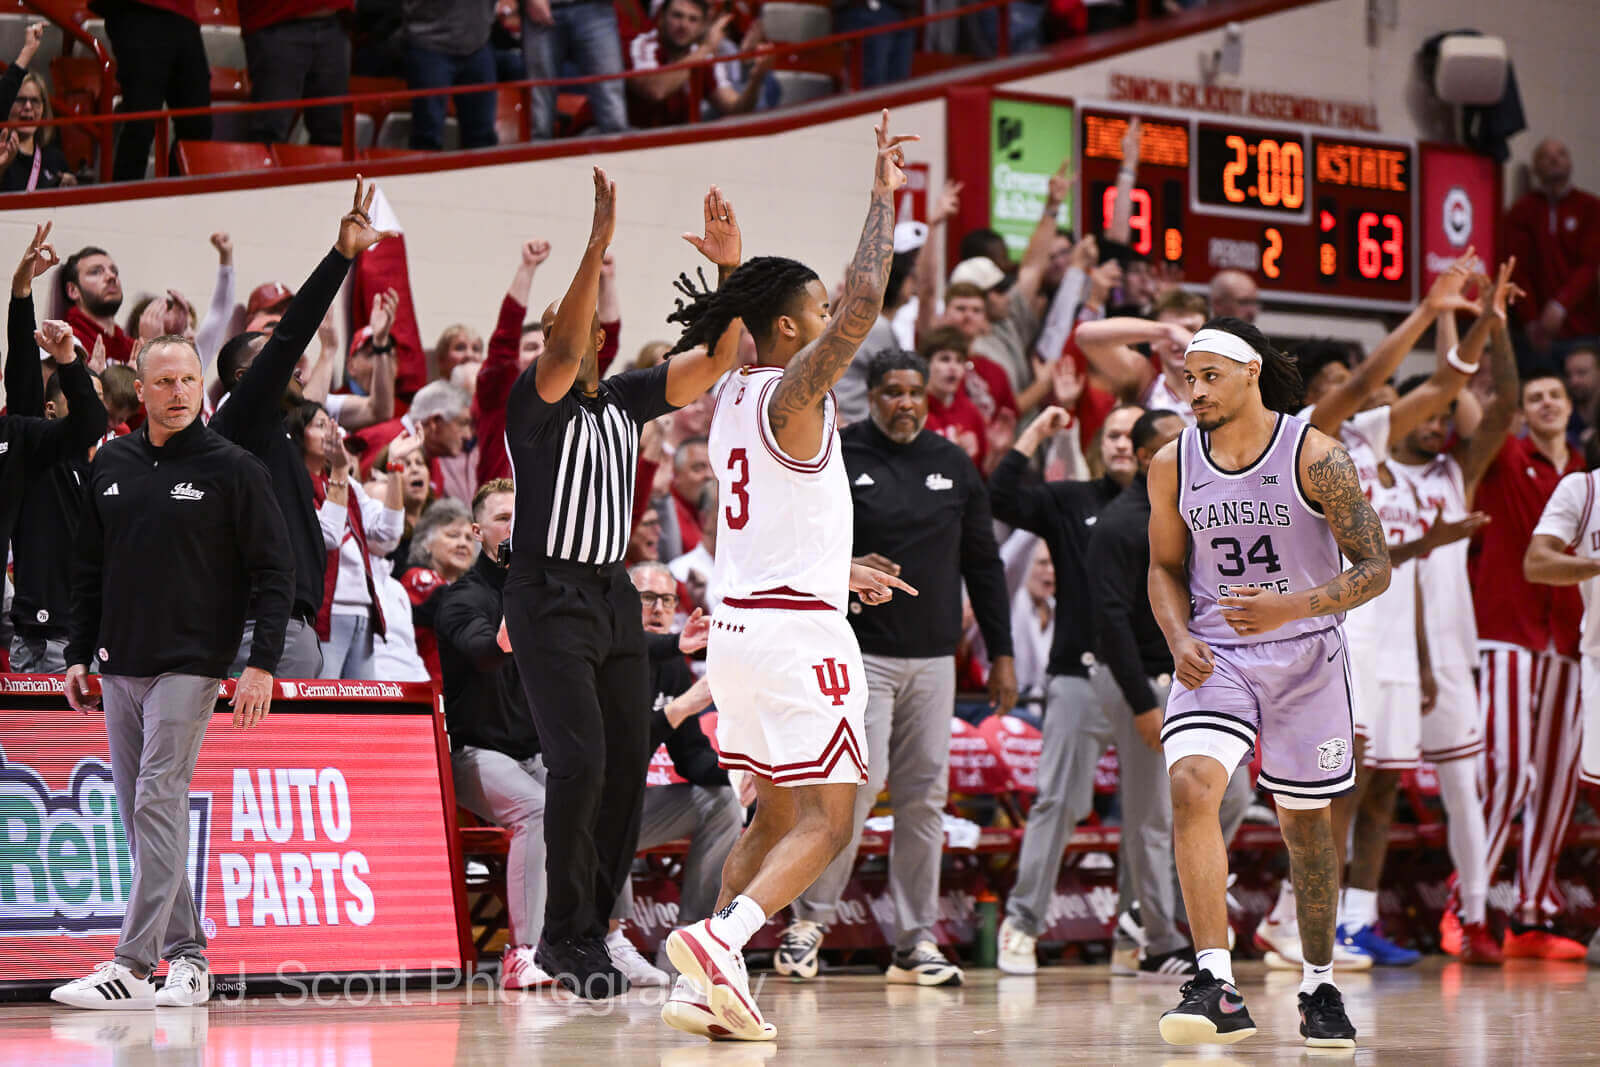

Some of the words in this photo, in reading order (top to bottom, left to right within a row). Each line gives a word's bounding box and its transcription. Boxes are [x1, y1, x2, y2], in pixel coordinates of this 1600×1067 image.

[1223, 135, 1304, 209] 2:00
[1262, 228, 1283, 279] 2
[1357, 212, 1404, 280] 63
[726, 448, 749, 530] 3
[1188, 500, 1291, 532] KANSAS
[1210, 534, 1282, 577] 34
[4, 678, 50, 692] American
[299, 682, 337, 697] German
[338, 683, 381, 697] American
[381, 684, 403, 698] Bank
[231, 767, 352, 843] AUTO
[219, 851, 377, 928] PARTS
